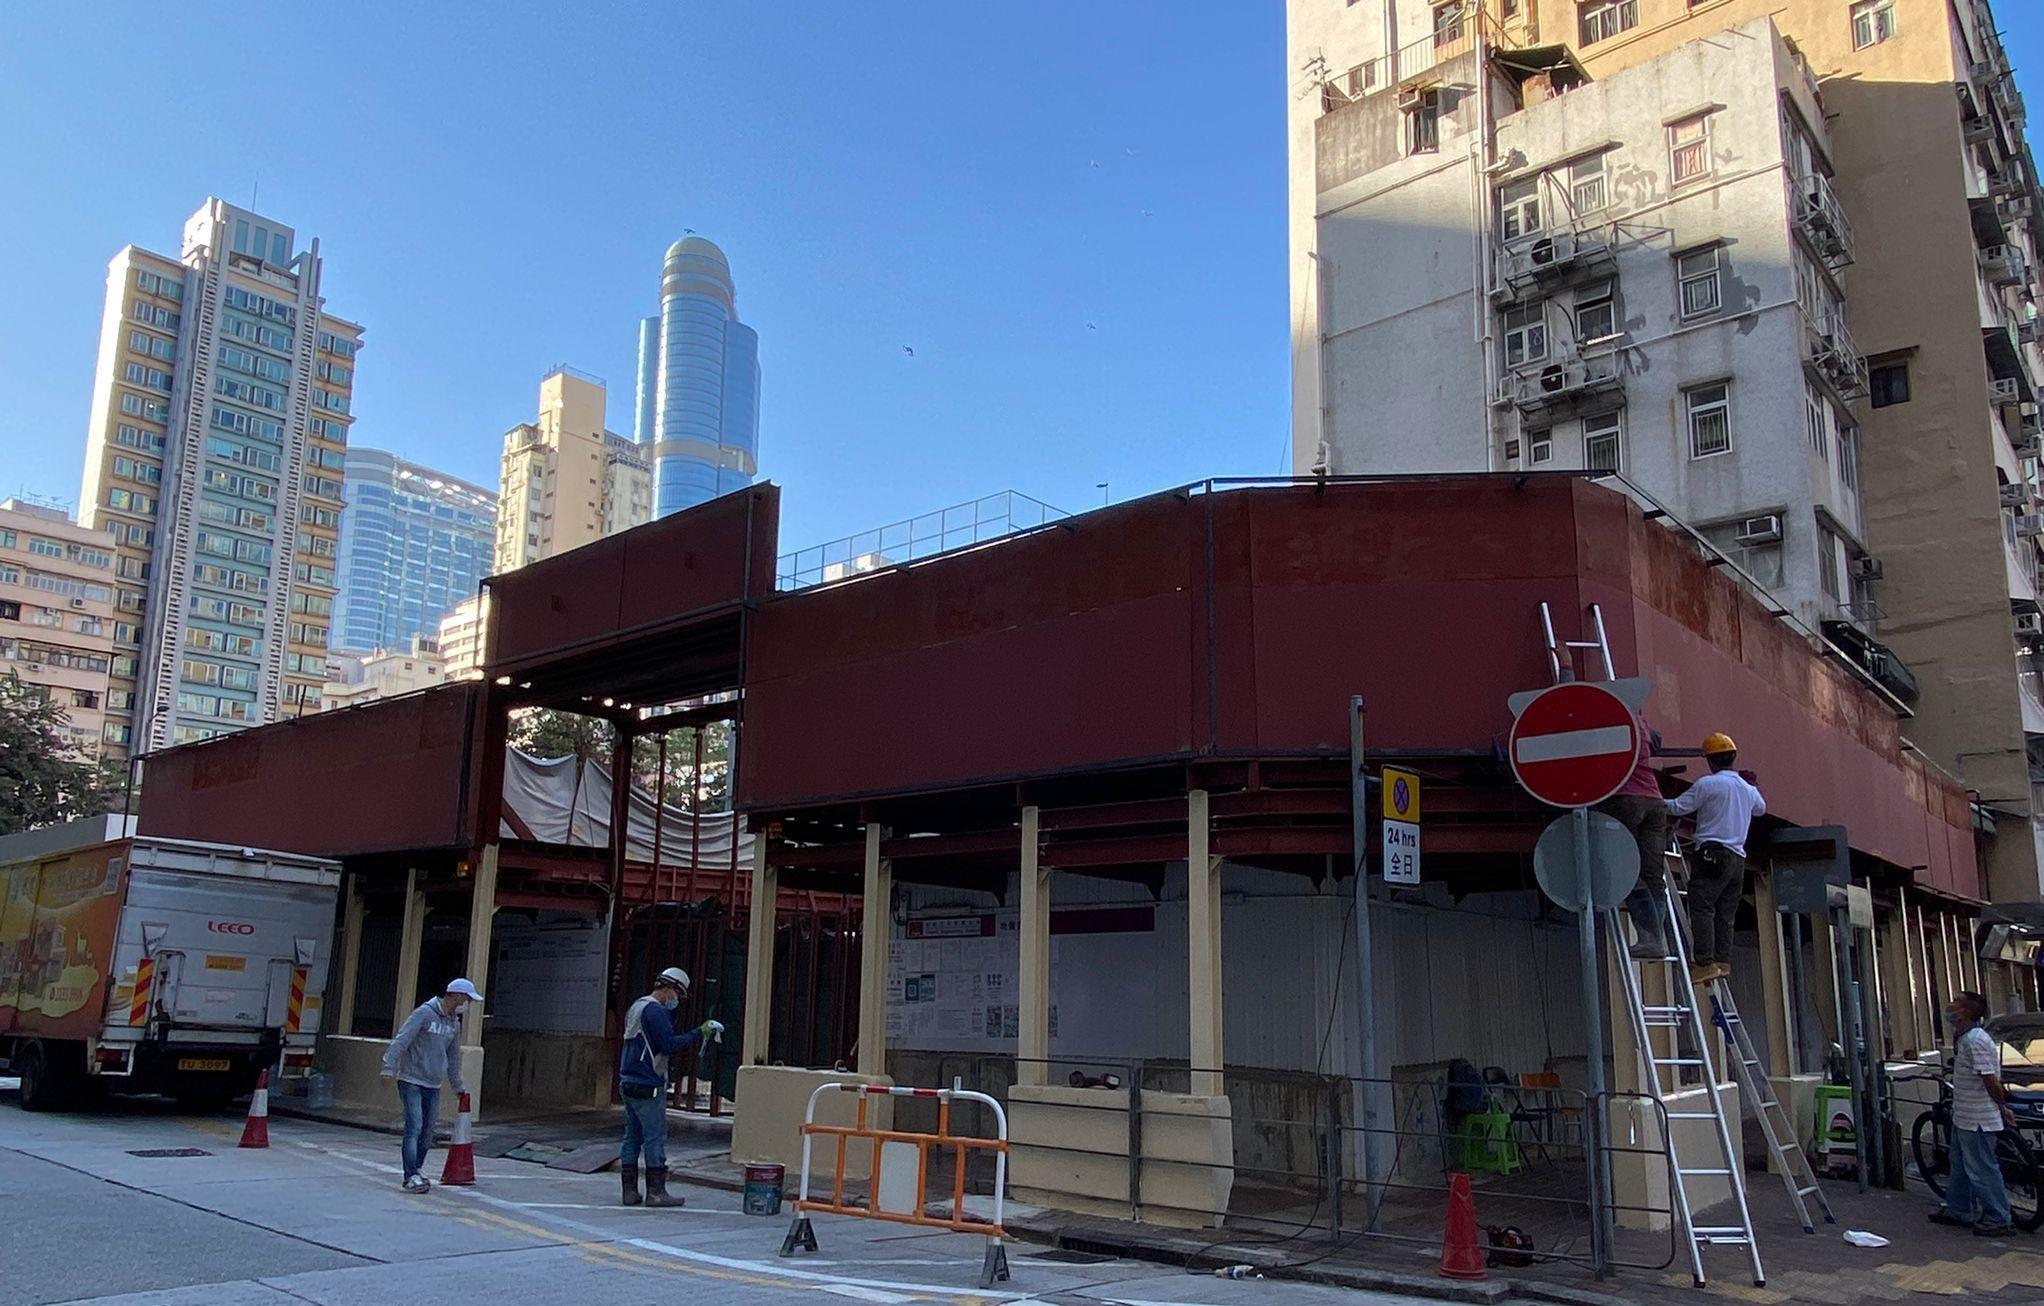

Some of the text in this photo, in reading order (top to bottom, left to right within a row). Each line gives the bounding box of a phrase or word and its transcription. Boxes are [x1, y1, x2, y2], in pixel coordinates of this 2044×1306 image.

[1388, 828, 1415, 847] 24 hrs
[1391, 853, 1412, 876] 全日
